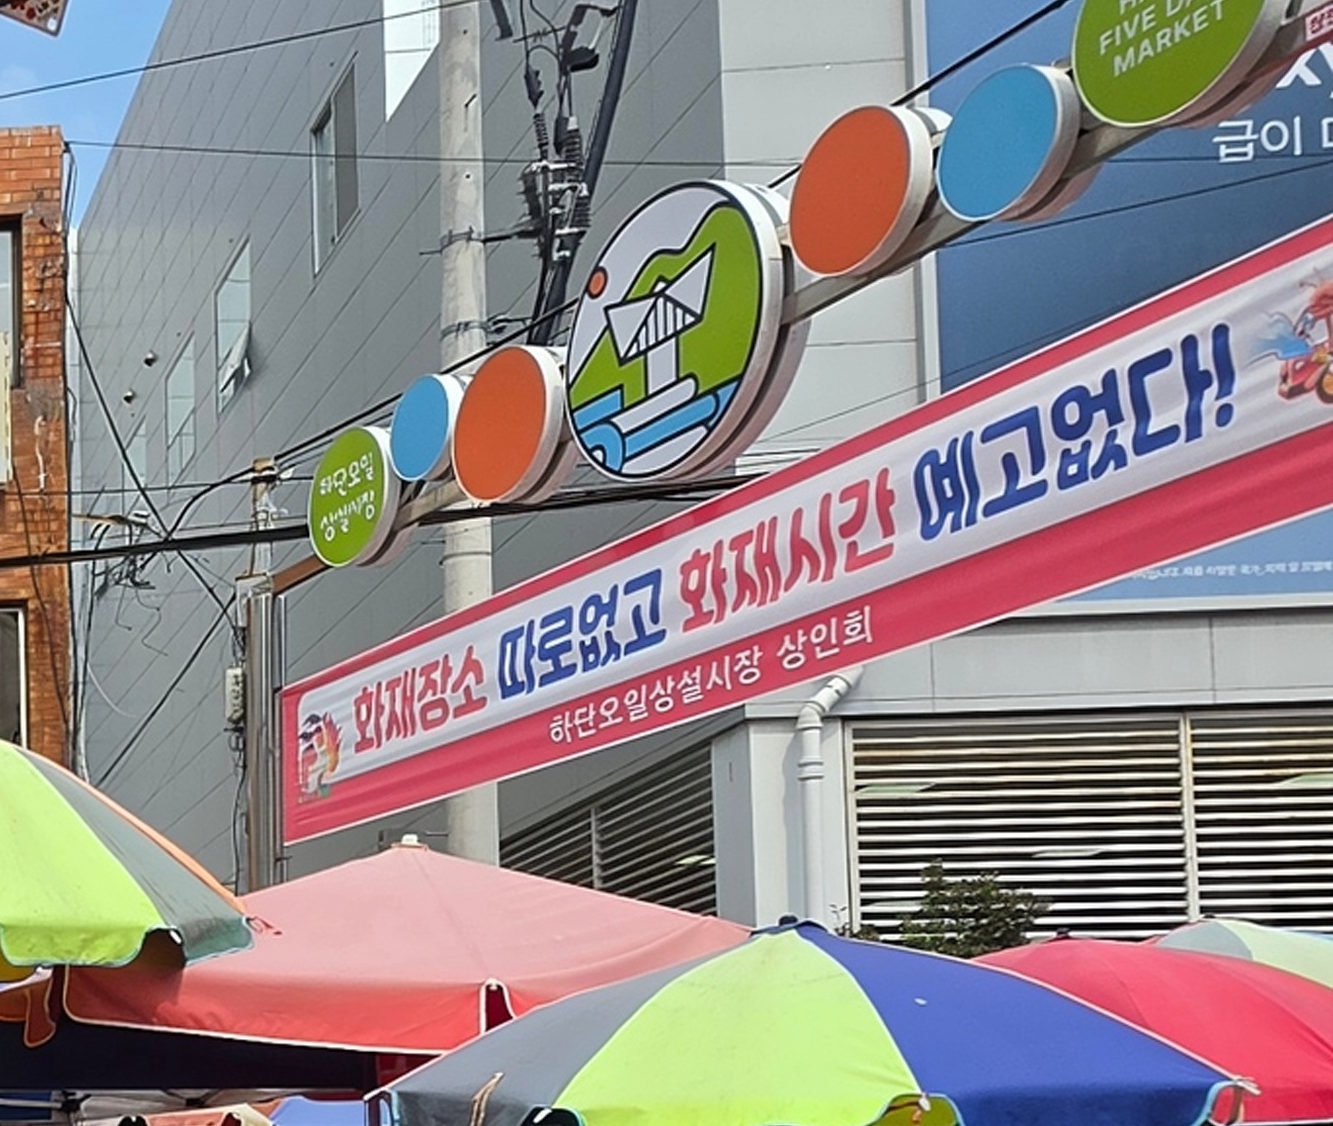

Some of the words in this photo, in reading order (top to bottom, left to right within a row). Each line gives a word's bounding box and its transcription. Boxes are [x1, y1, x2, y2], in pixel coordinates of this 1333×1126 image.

[1099, 6, 1156, 56] FIVE
[1113, 1, 1225, 78] MARKET
[1212, 116, 1302, 163] 급이
[353, 645, 488, 754] 화재장소
[498, 568, 668, 700] 따로없고
[679, 467, 898, 635] 화재시간
[913, 322, 1236, 541] 예고없다!
[548, 649, 766, 745] 하단오일상설시장
[776, 605, 874, 669] 상인회
